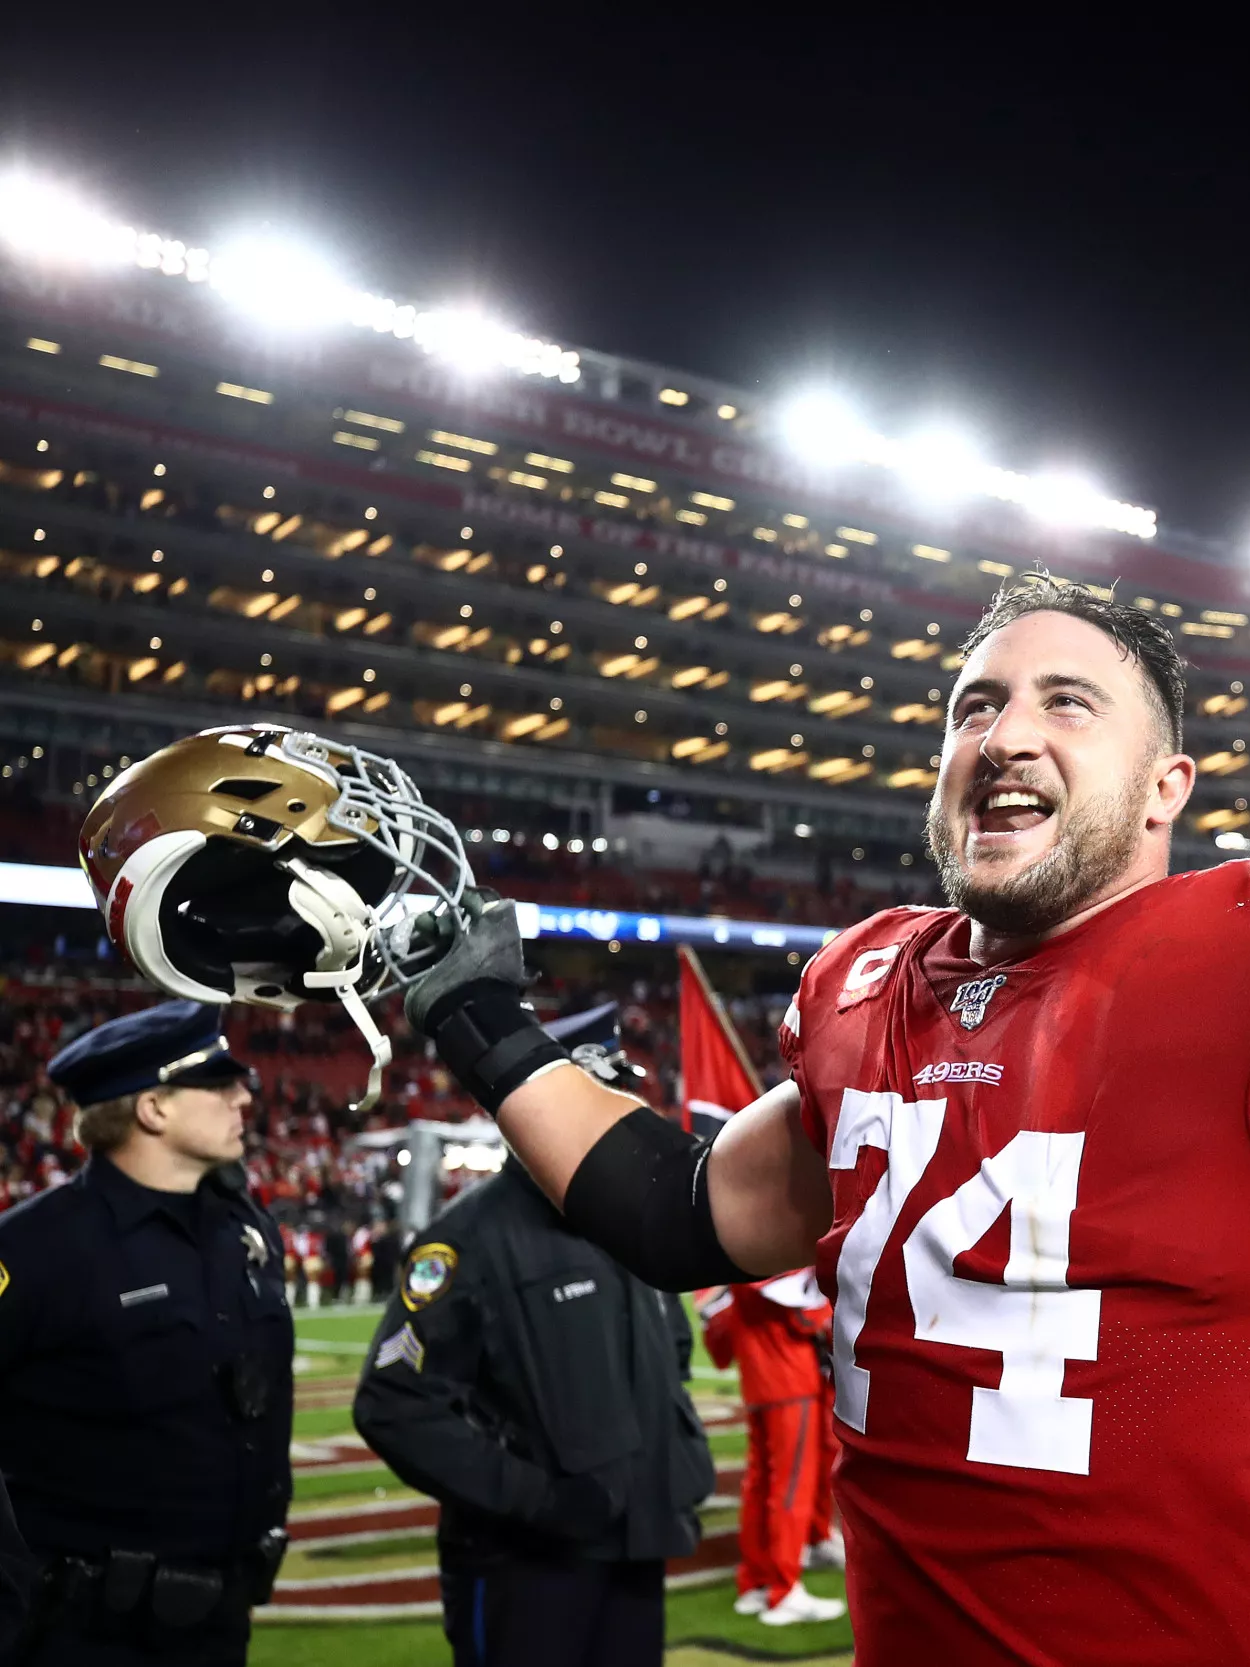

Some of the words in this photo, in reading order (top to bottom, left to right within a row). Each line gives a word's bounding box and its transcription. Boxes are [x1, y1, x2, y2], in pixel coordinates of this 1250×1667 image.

[845, 944, 901, 991] C
[911, 1061, 1005, 1086] 49ERS
[829, 1087, 1102, 1476] 74
